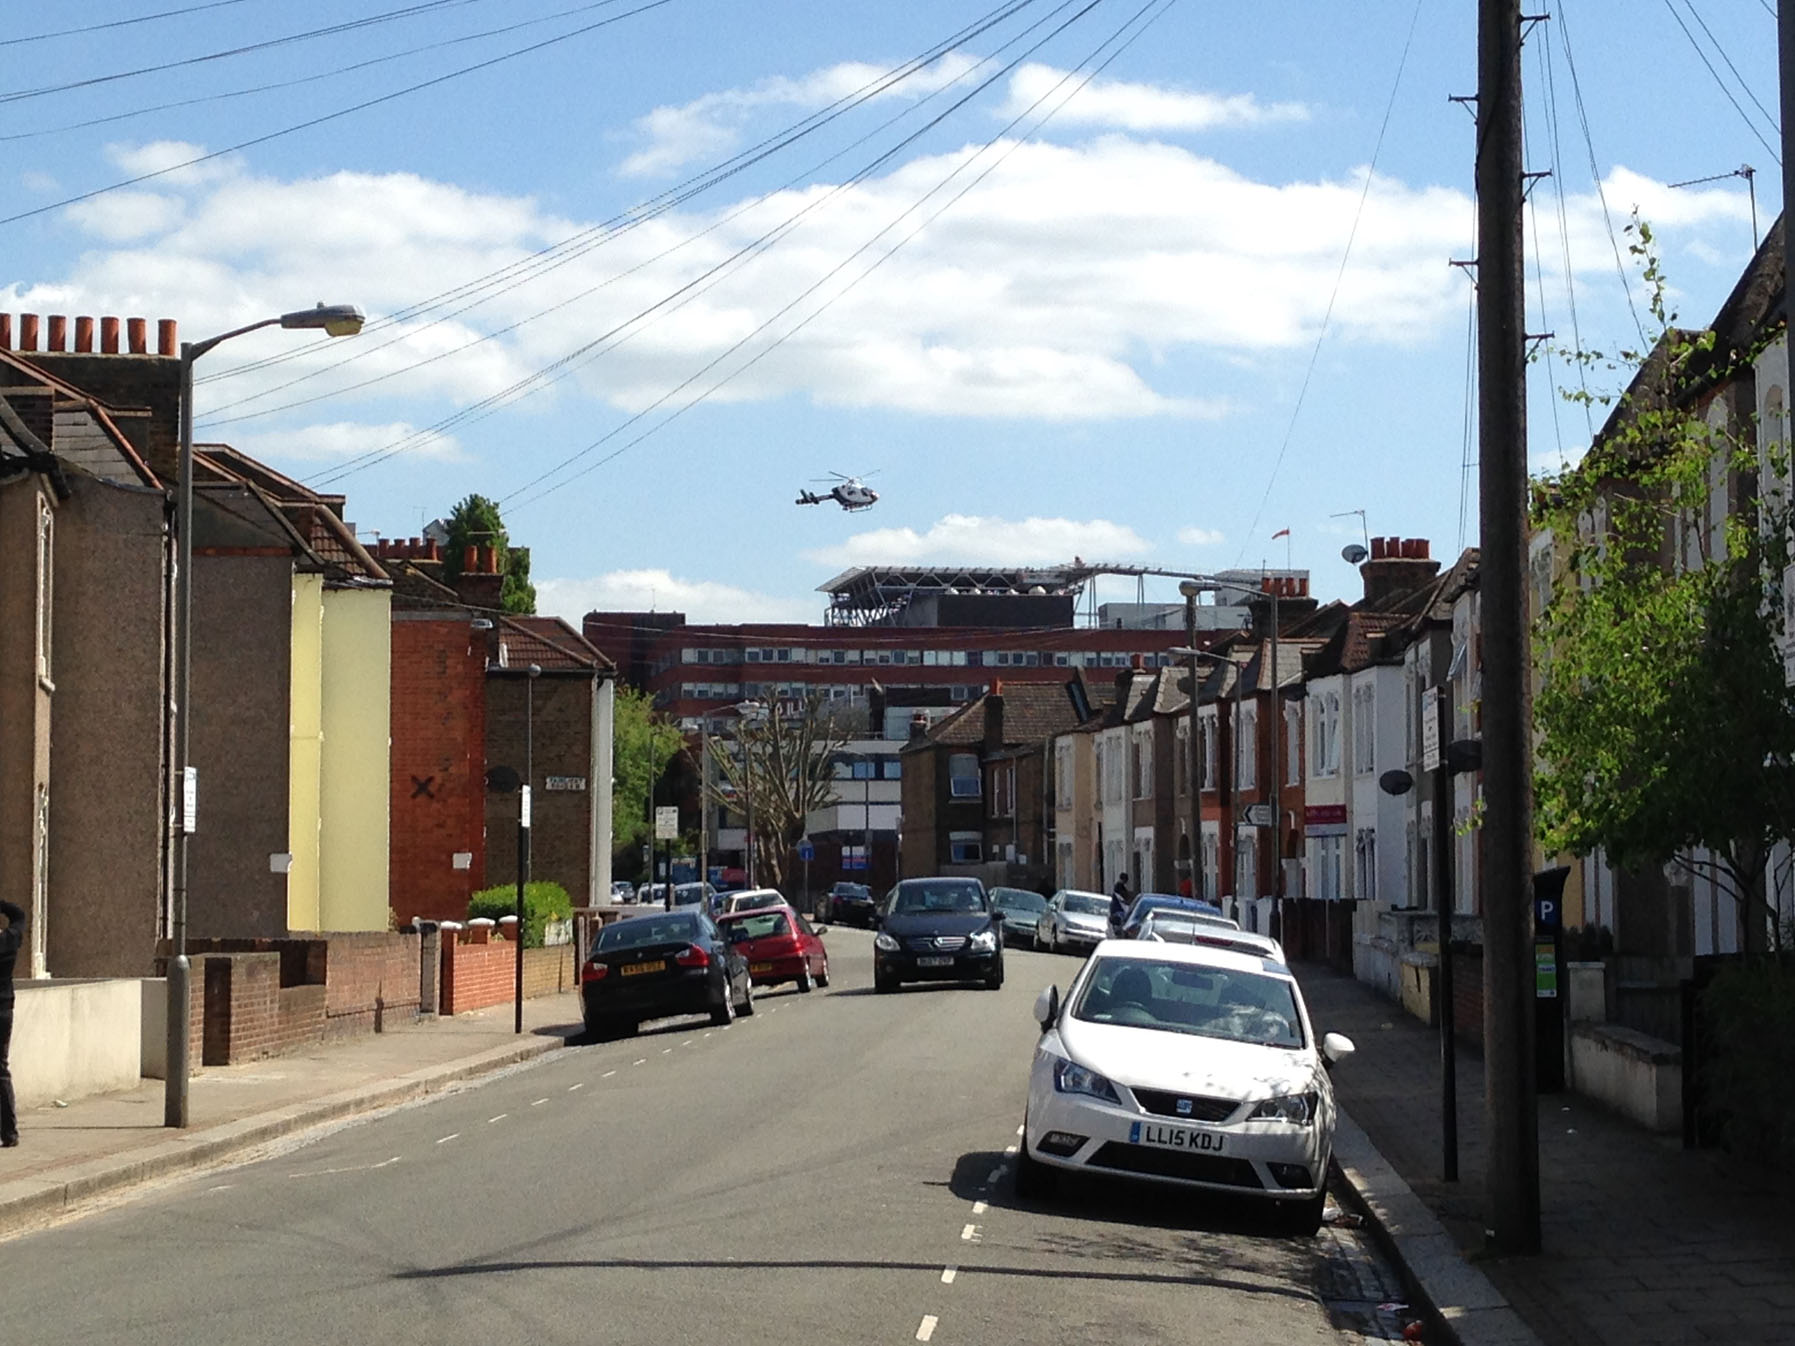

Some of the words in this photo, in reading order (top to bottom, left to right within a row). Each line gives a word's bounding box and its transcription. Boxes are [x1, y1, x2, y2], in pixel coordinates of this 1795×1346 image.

[1541, 900, 1553, 920] P
[1146, 1126, 1185, 1146] LL15
[1189, 1131, 1224, 1151] KDJ
